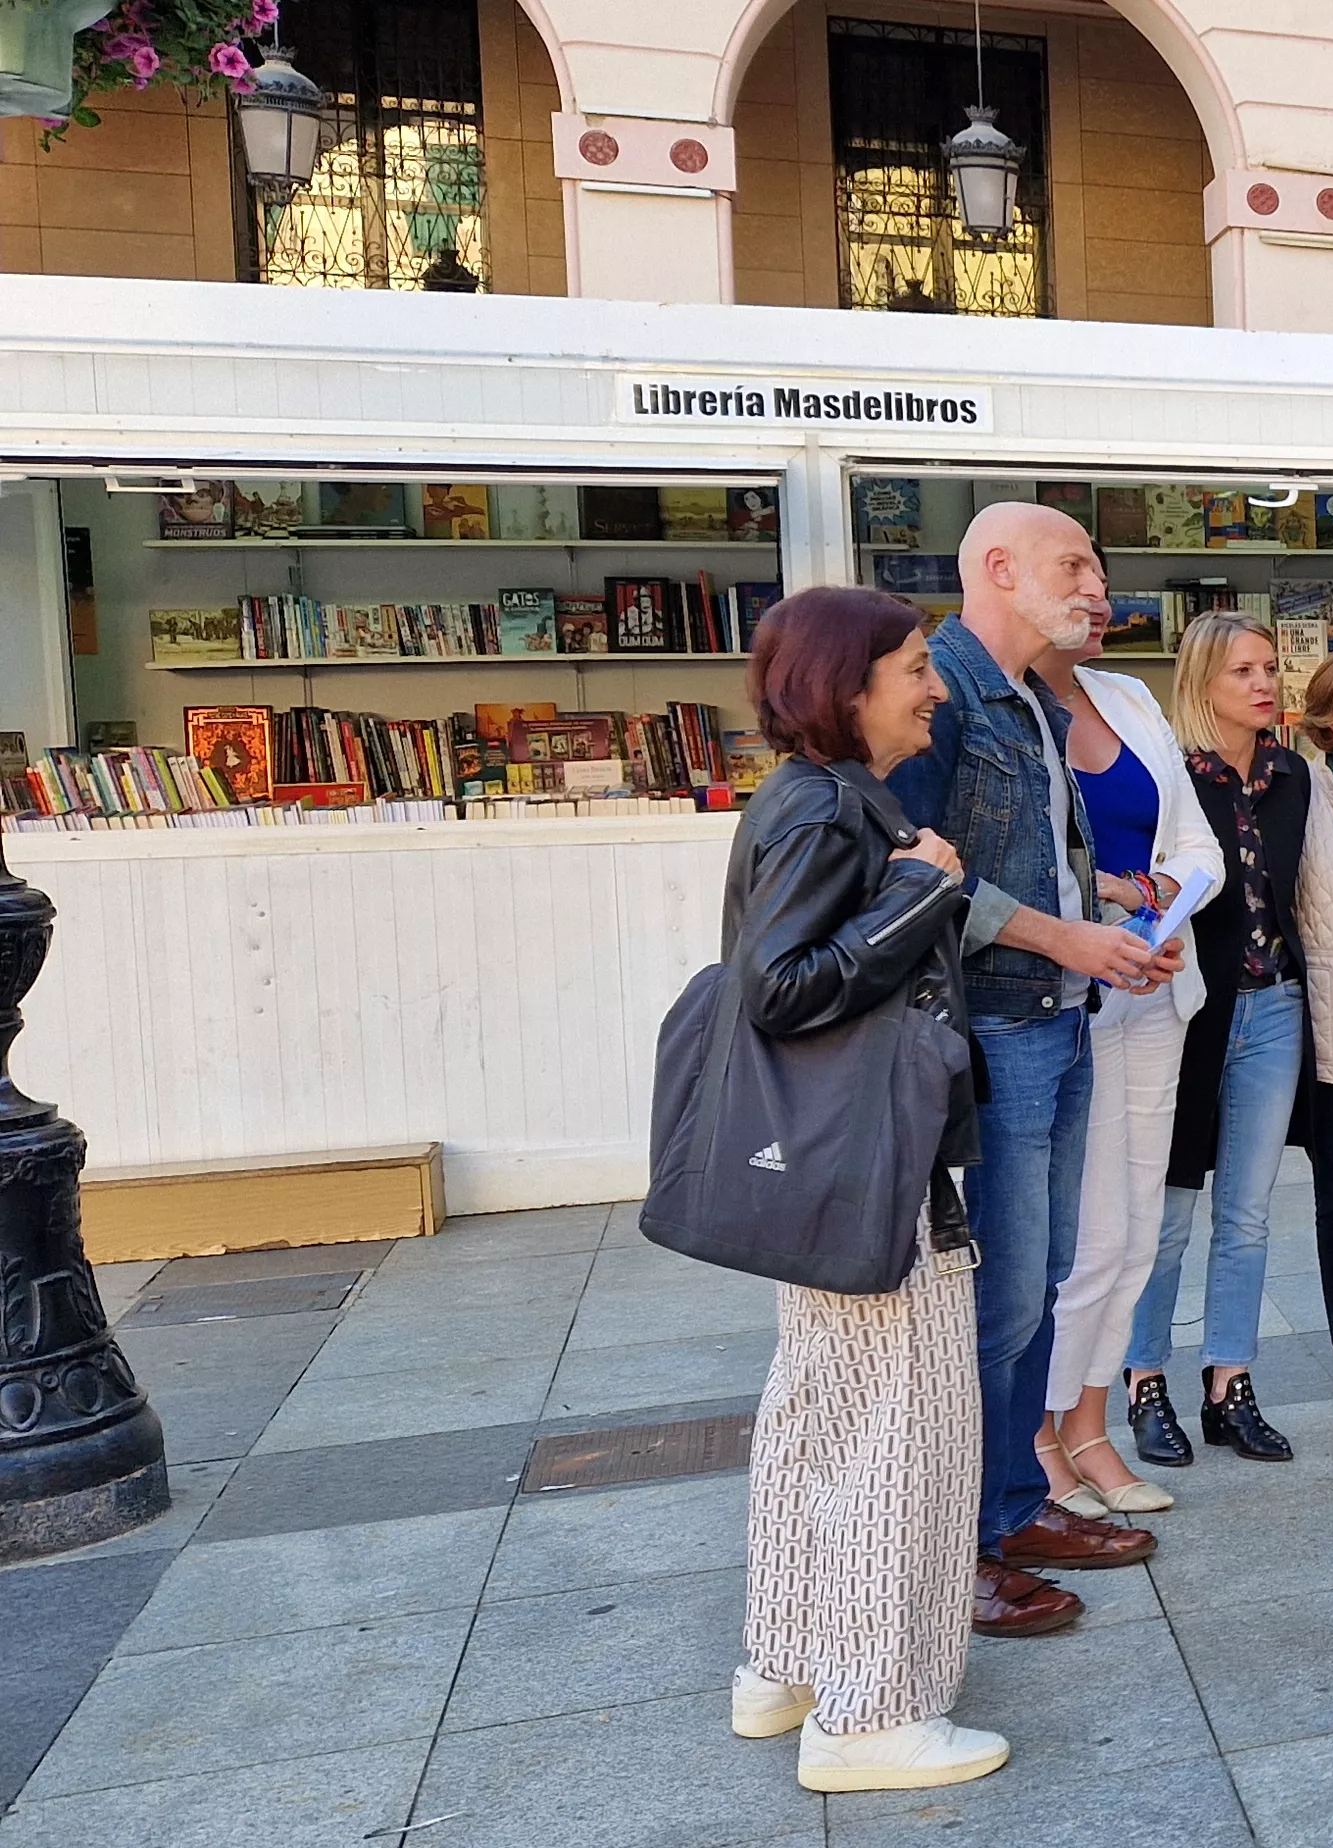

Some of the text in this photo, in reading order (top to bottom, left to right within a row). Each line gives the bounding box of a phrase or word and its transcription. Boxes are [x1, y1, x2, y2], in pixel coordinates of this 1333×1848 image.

[633, 383, 977, 425] Librería Masdelibros
[503, 591, 540, 607] GATOS
[1290, 628, 1304, 637] UNA
[1290, 636, 1319, 645] GRANDE
[1290, 645, 1311, 653] LIBRE
[748, 1157, 787, 1171] adidas
